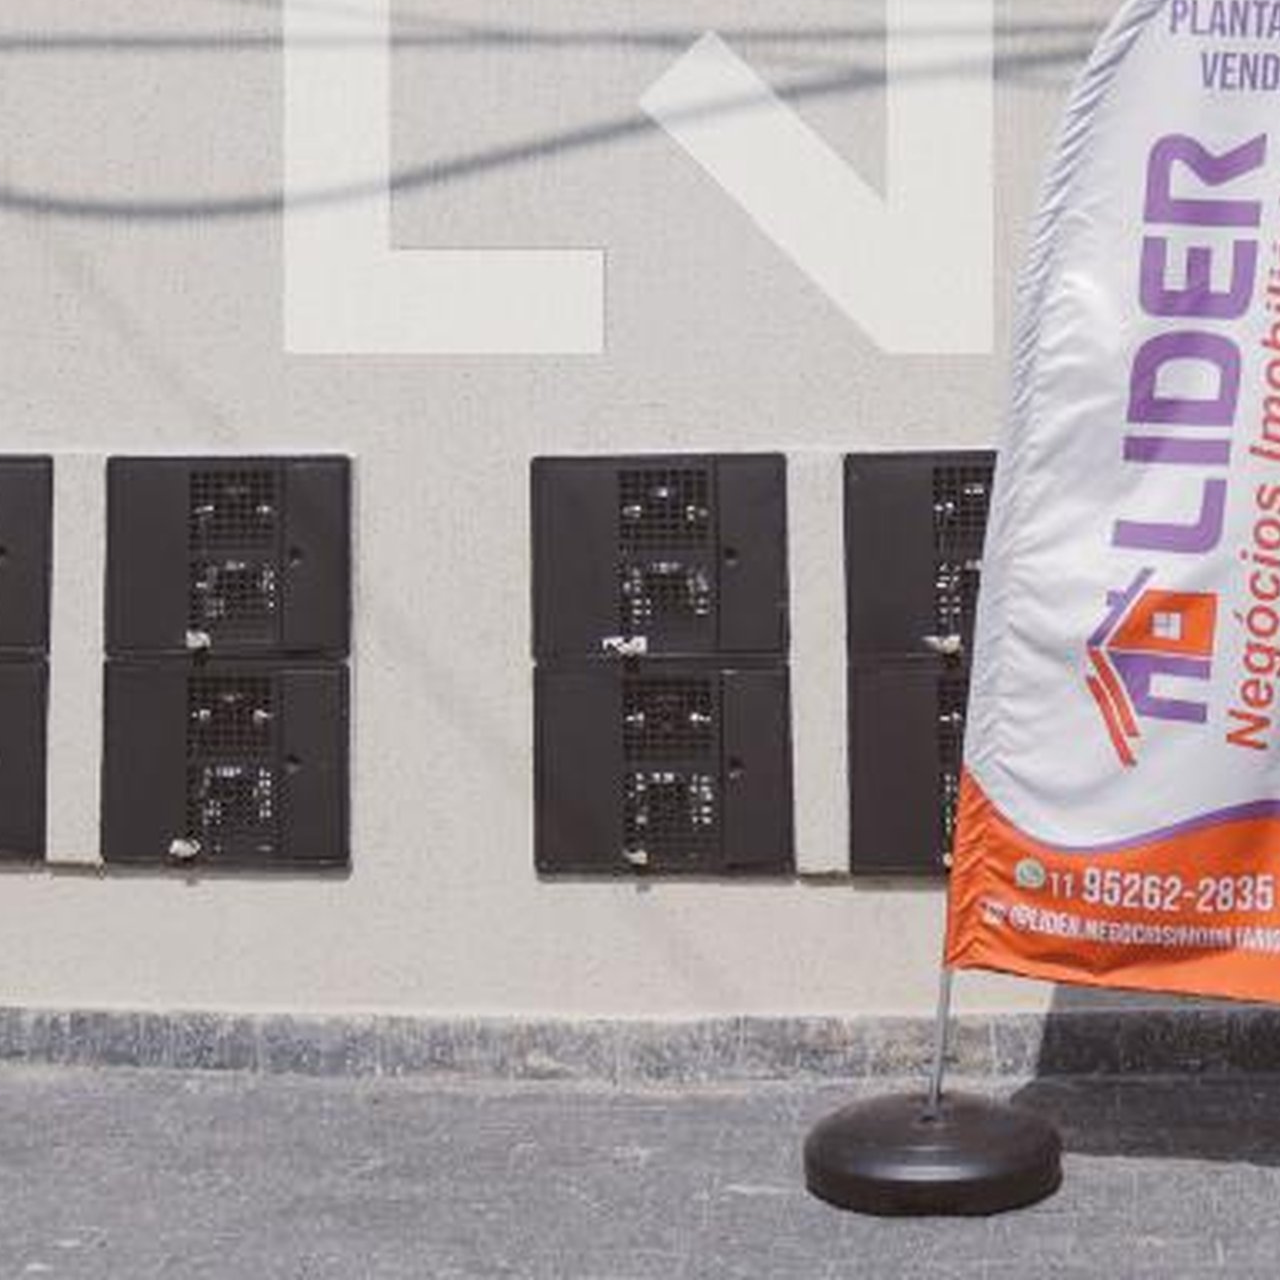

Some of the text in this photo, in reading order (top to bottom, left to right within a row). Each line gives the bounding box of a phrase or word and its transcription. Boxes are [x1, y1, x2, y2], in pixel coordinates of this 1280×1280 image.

[1111, 131, 1268, 555] LIDER
[1048, 866, 1276, 913] 11 95262-2835
